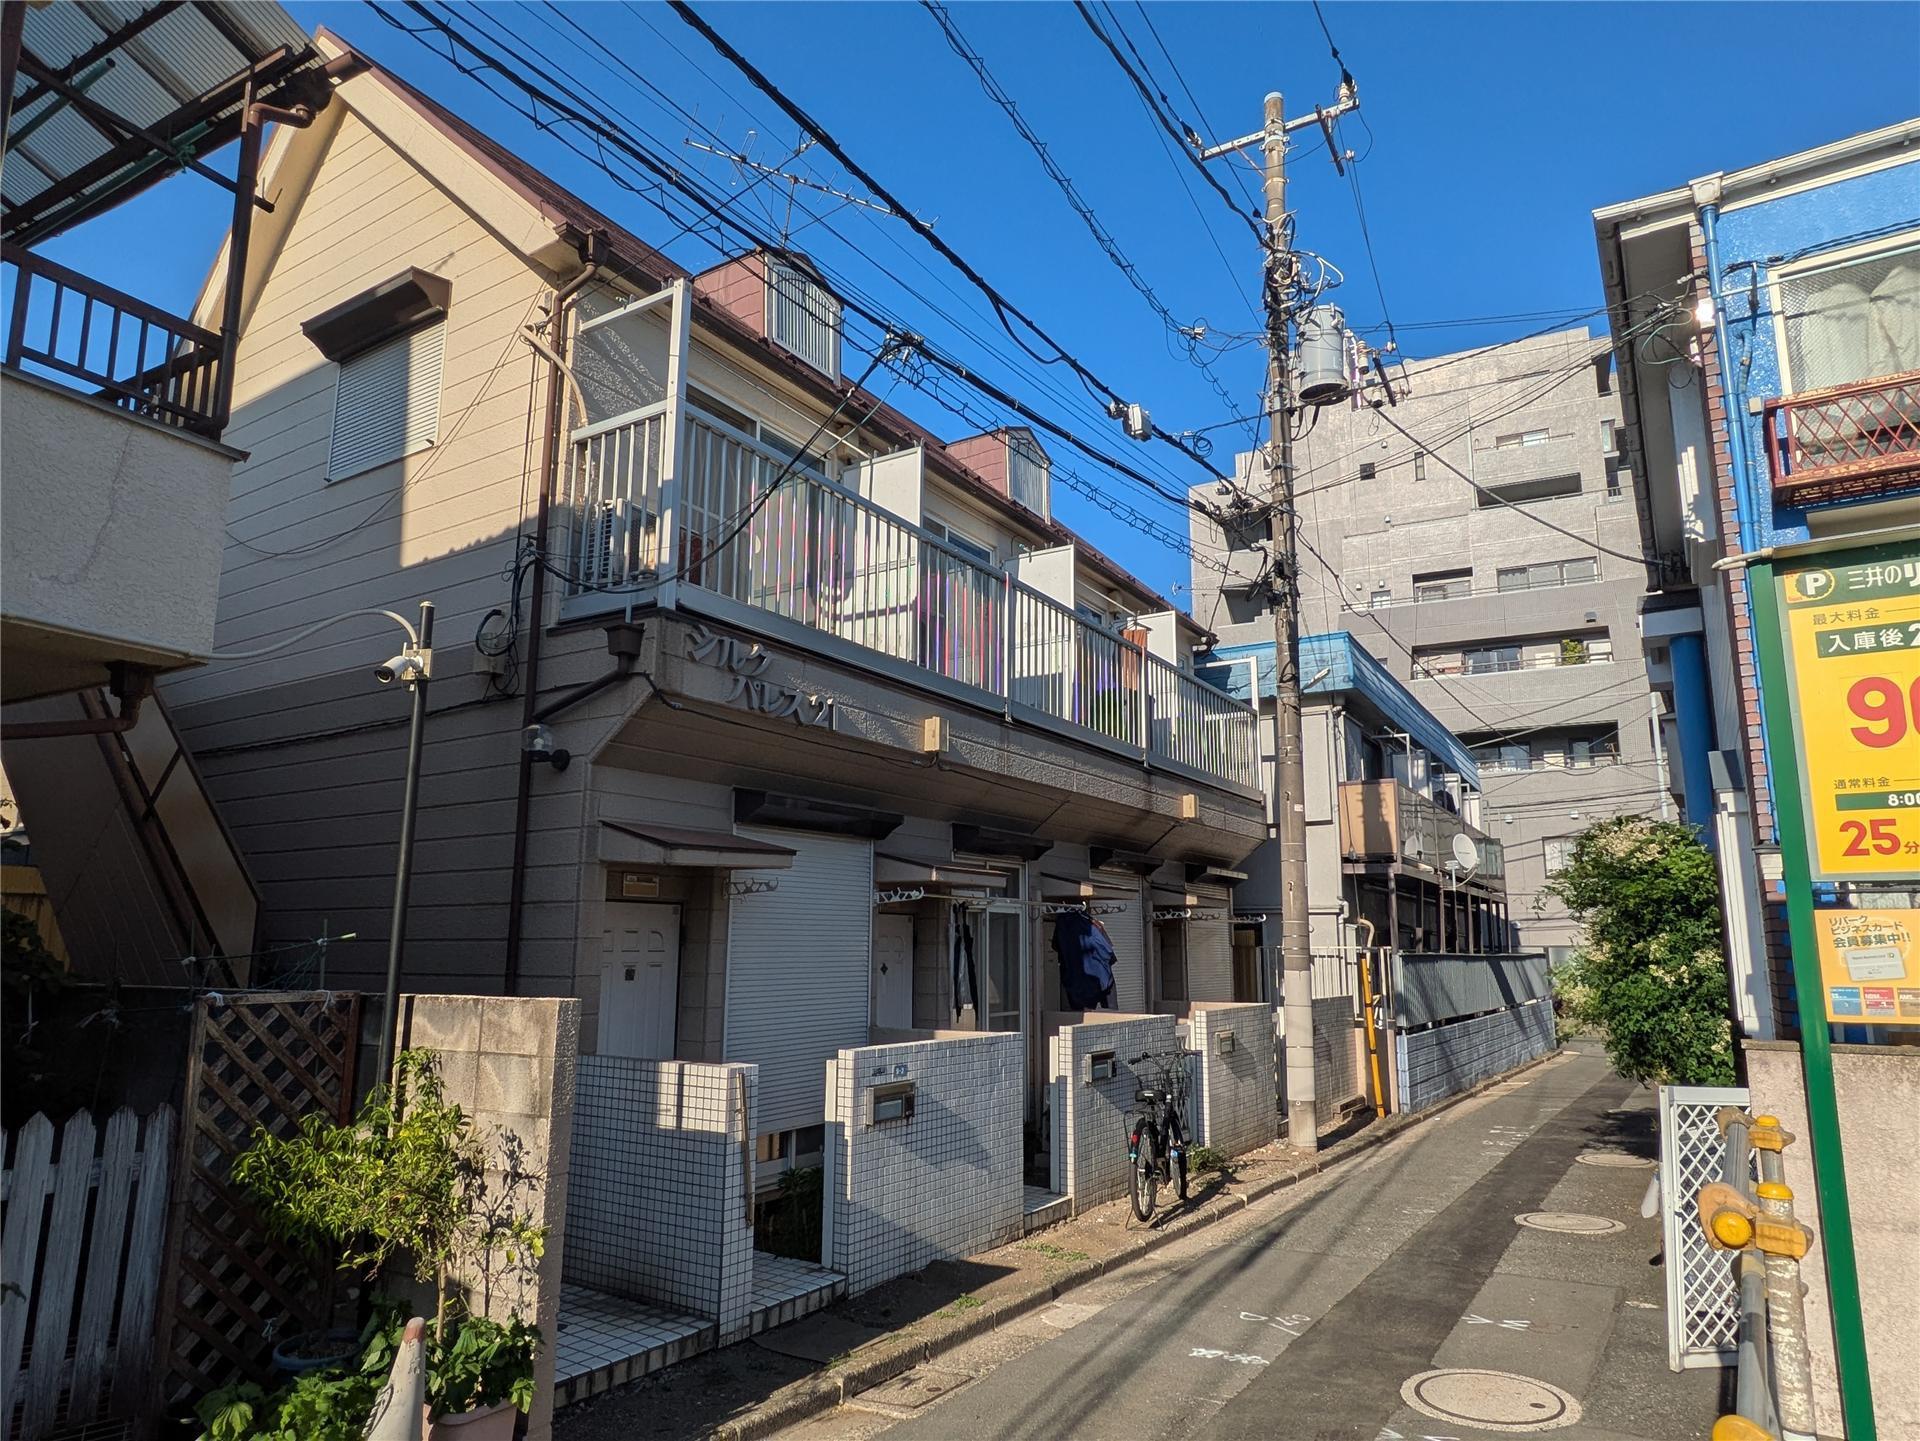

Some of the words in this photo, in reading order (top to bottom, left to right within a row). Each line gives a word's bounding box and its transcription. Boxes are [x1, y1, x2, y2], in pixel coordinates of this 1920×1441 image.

[1813, 607, 1880, 626] 最大料金
[687, 624, 775, 677] シルク
[1847, 676, 1920, 748] 9
[1834, 776, 1890, 790] 通常料金
[1831, 921, 1903, 936] ビジネスカード
